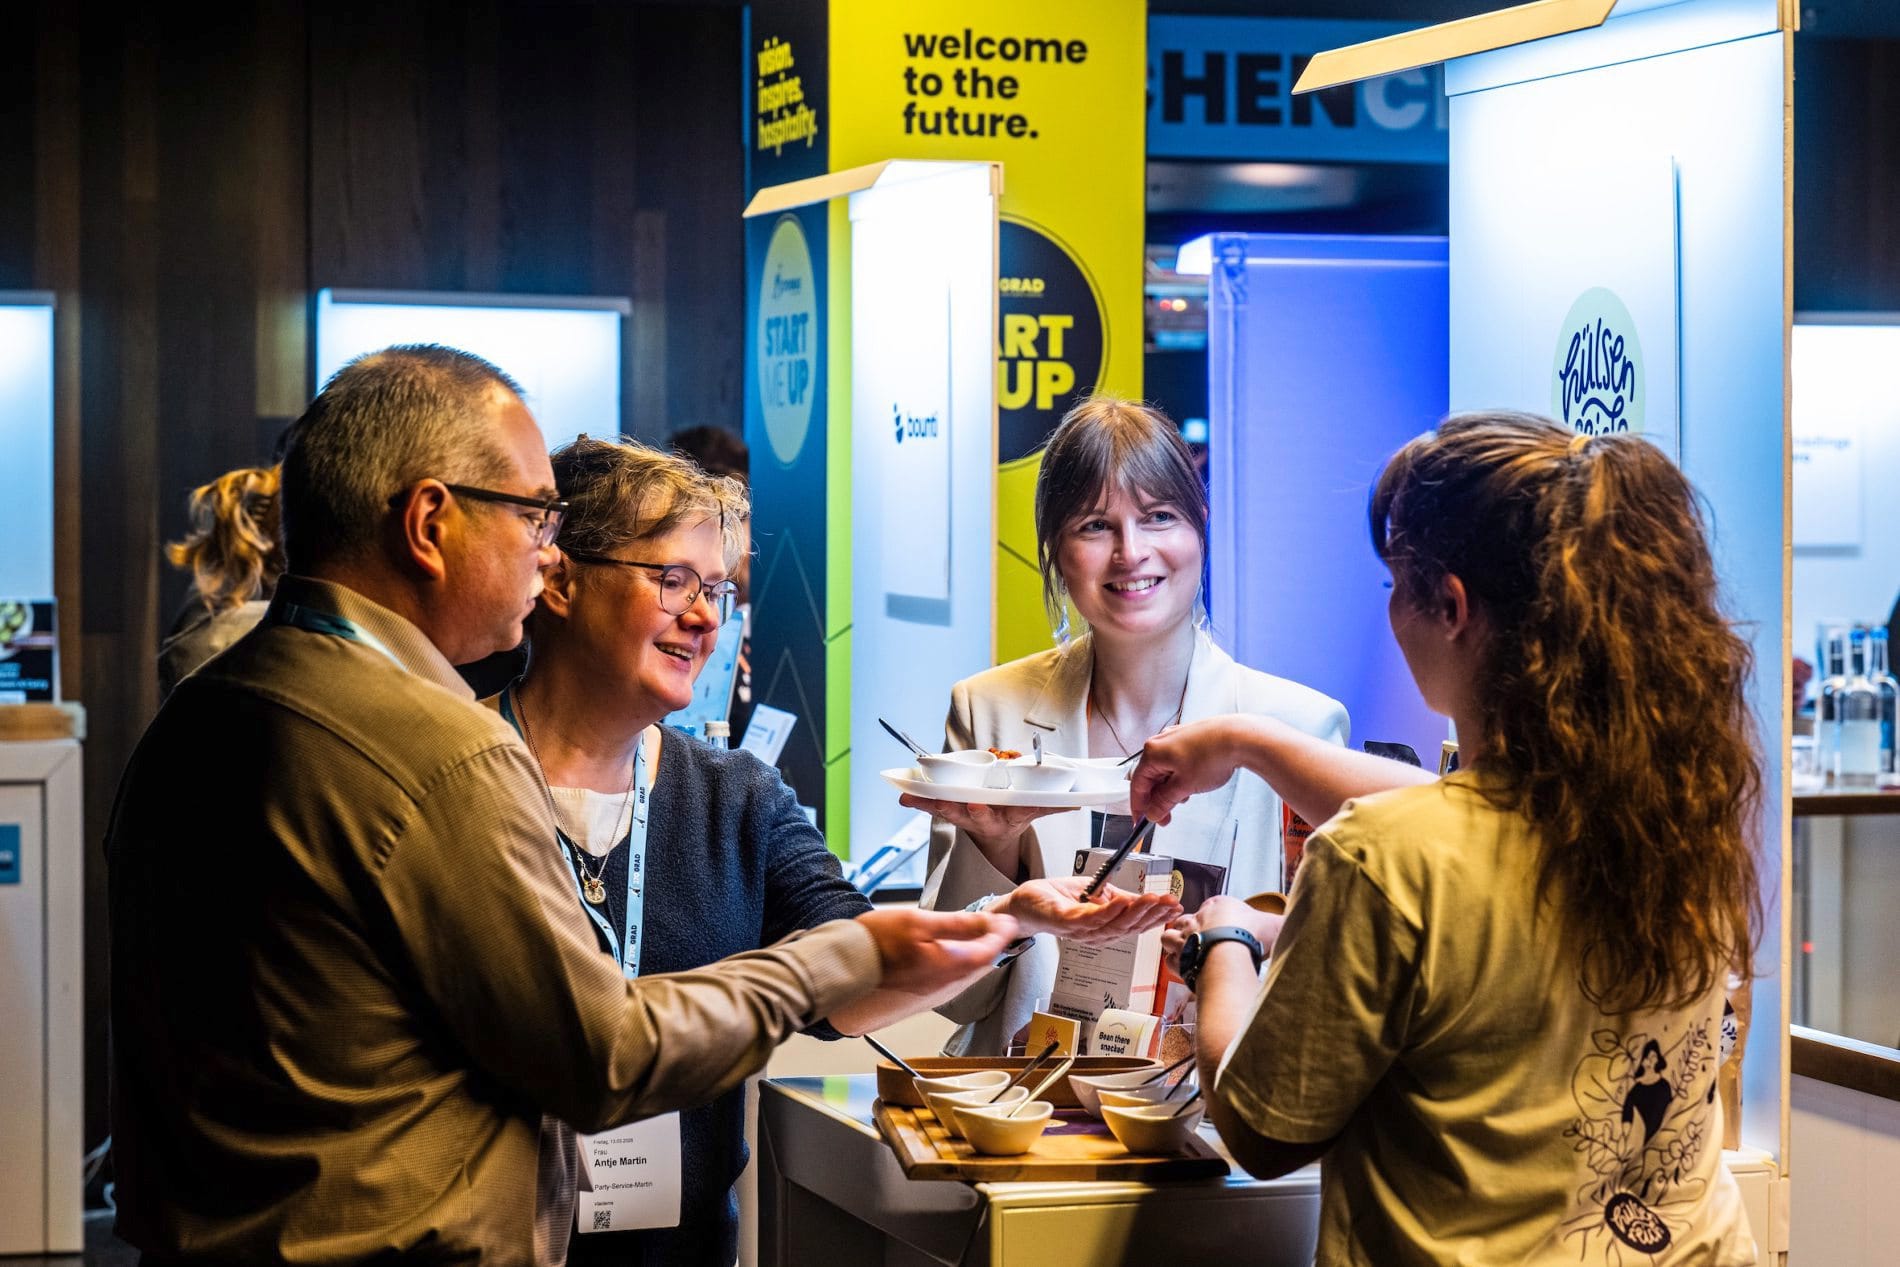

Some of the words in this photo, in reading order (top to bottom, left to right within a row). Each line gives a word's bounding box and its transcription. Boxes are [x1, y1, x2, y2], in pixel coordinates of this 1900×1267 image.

[904, 29, 1088, 65] welcome
[904, 67, 943, 97] to
[953, 67, 1019, 99] the
[1146, 50, 1449, 130] HENC
[904, 102, 1039, 139] future.
[765, 312, 809, 357] START
[788, 358, 809, 405] UP
[1000, 360, 1075, 411] UP
[1099, 1032, 1114, 1042] Bean
[1114, 1035, 1130, 1046] there
[1100, 1043, 1125, 1055] snacked
[594, 1159, 617, 1168] Antje
[619, 1156, 647, 1166] Martin
[594, 1181, 653, 1191] Party-Service-Martin
